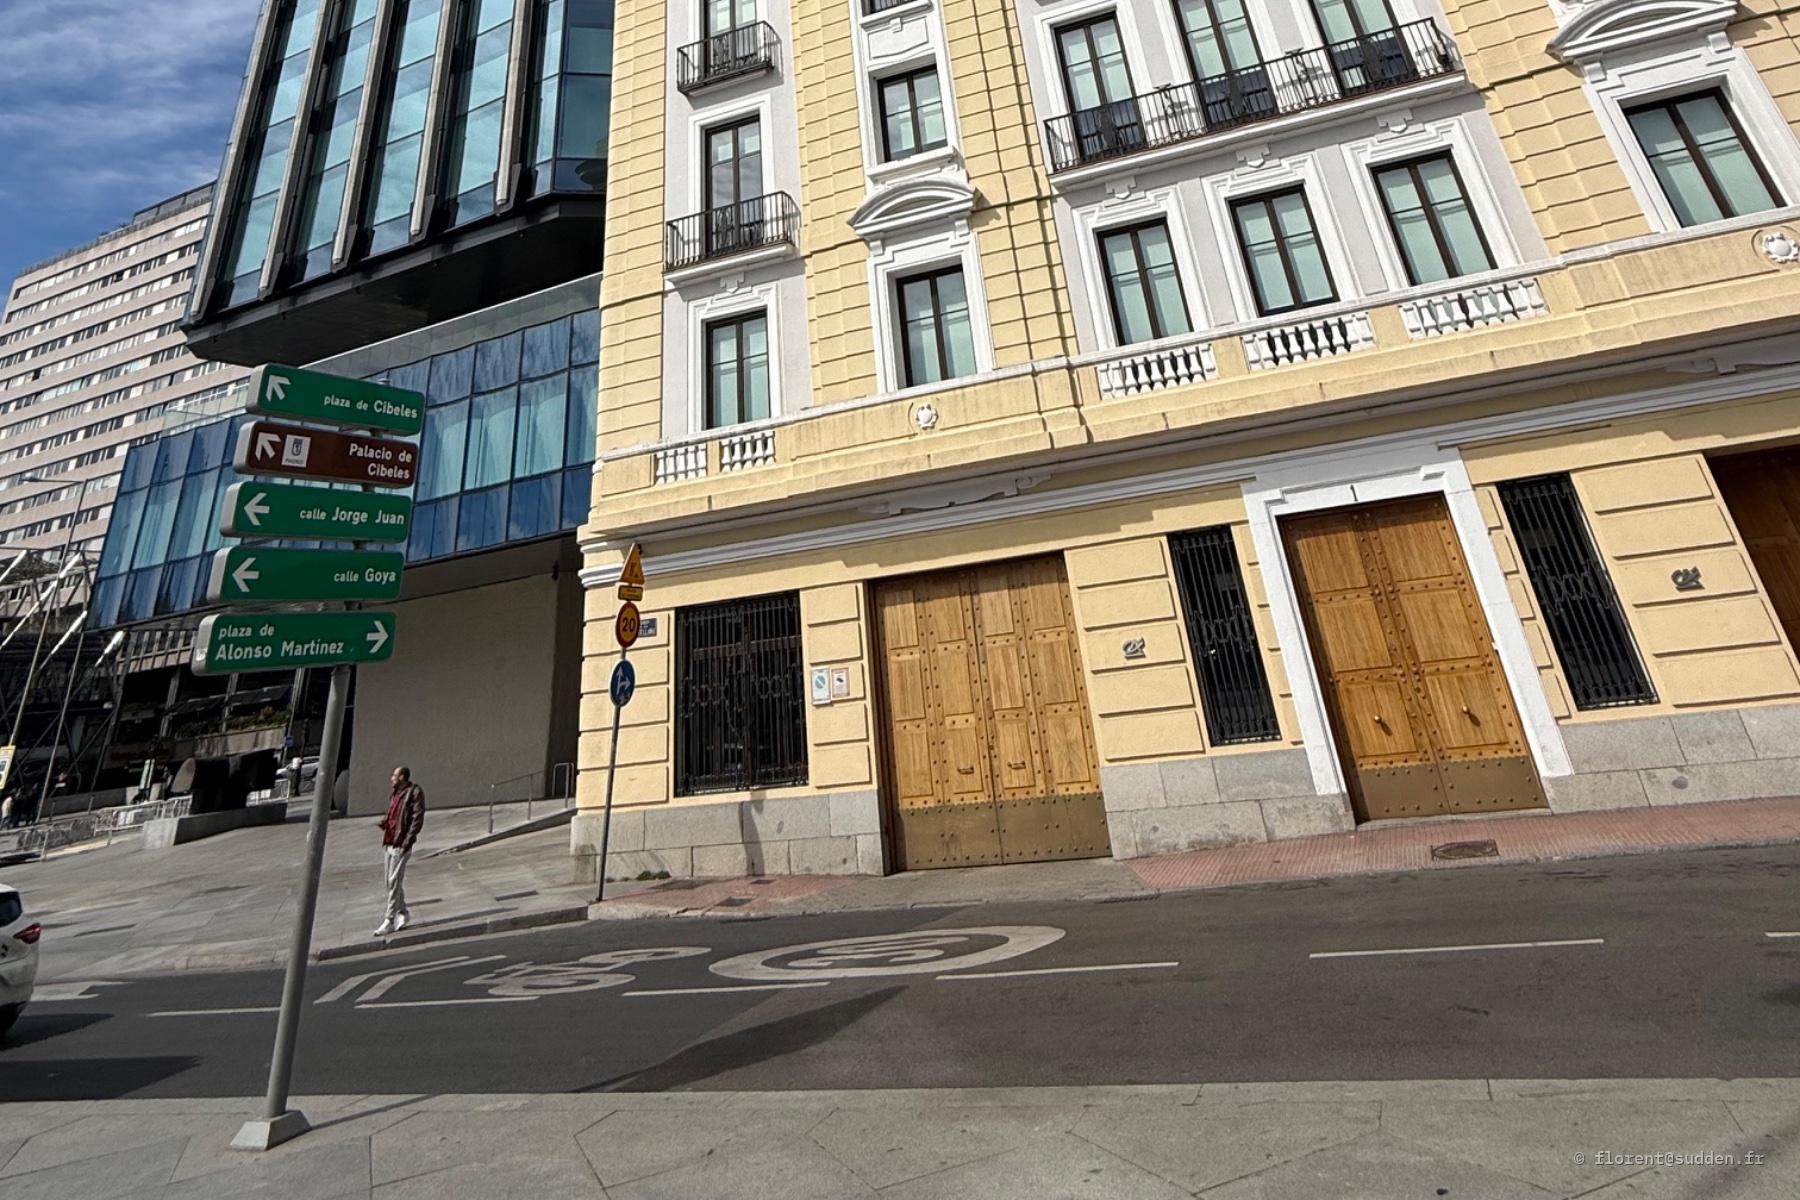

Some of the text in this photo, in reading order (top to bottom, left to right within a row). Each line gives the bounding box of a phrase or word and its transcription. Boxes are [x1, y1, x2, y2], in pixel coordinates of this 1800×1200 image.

[324, 395, 418, 419] plaza de Cibeles
[349, 443, 412, 462] Palacio de
[367, 463, 411, 479] Cibeles
[1350, 484, 1358, 501] 1
[299, 506, 405, 525] calle Jorge Juan
[333, 567, 396, 584] calle Goya
[218, 624, 275, 640] plaza de
[621, 617, 636, 633] 20
[215, 639, 344, 661] Alonso Martínez
